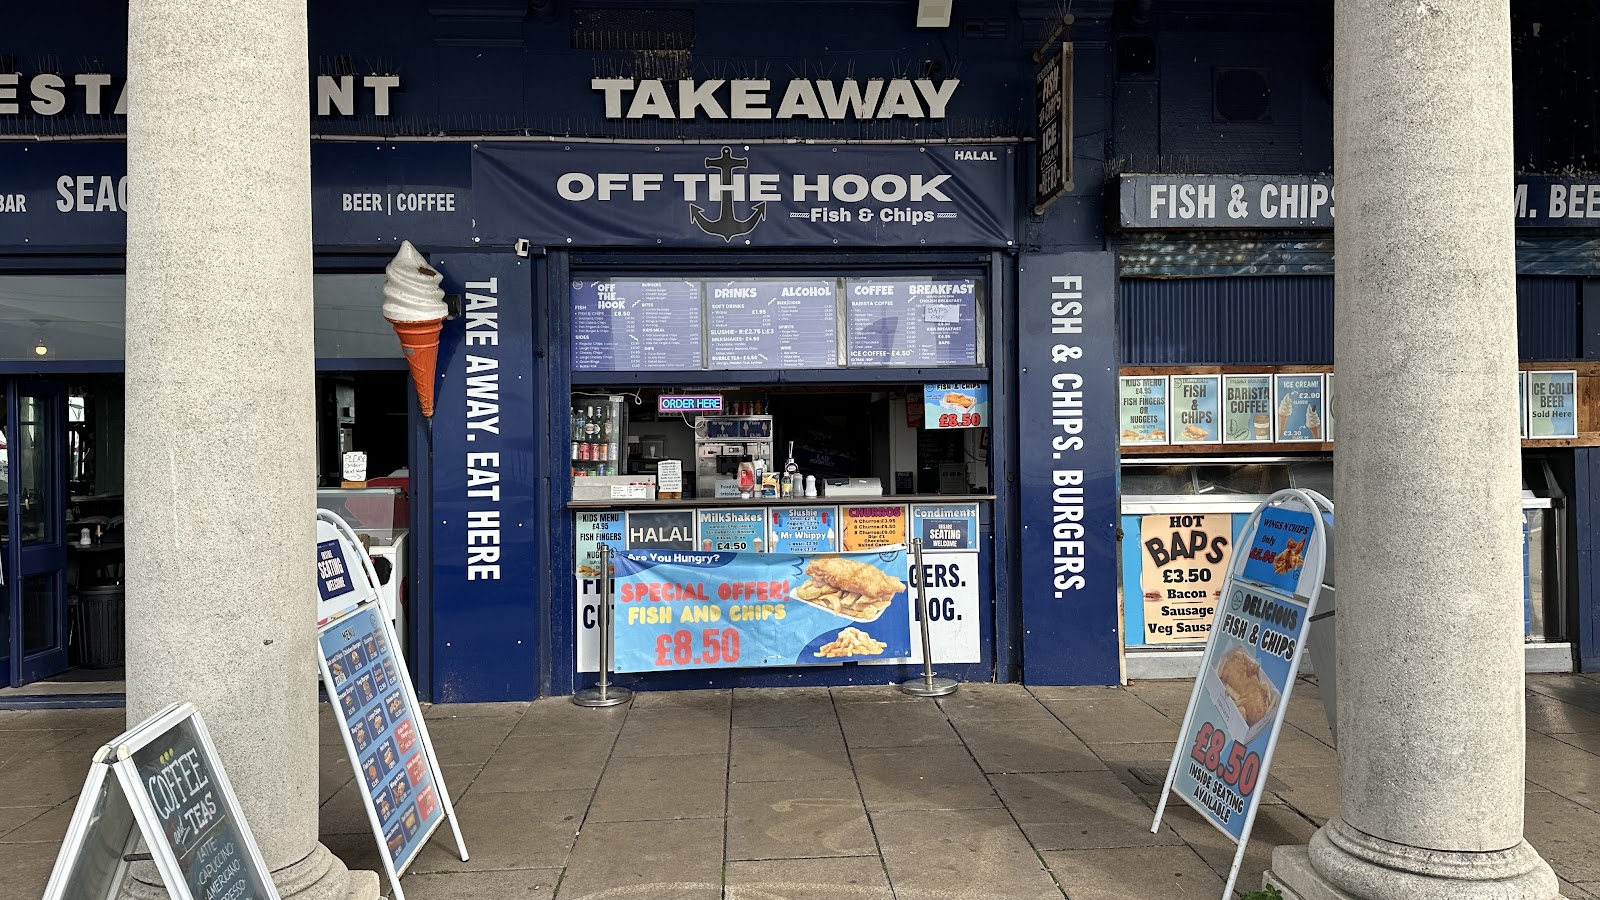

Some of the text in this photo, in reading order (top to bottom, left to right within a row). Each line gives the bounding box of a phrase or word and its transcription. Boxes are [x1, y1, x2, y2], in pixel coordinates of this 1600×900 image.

[591, 78, 960, 119] TAKEAWAY
[1042, 121, 1057, 154] ICE
[954, 150, 997, 161] HALAL
[556, 172, 953, 202] OFF THE HOOK
[343, 193, 455, 212] BEER COFFEE
[1149, 184, 1217, 219] FISH
[1227, 184, 1249, 219] &
[811, 207, 935, 224] Fish & Chips
[597, 283, 616, 292] OFF
[714, 288, 758, 298] DRINKS
[781, 287, 832, 296] ALCOHOL
[854, 286, 894, 296] COFFEE
[908, 284, 974, 294] BREAKFAST
[597, 292, 617, 301] THE
[597, 300, 626, 309] HOOK
[1184, 384, 1206, 398] FISH
[1228, 387, 1270, 400] BARISTA
[1532, 382, 1574, 396] ICE COLD
[662, 398, 720, 409] ORDER HERE
[1191, 399, 1198, 410] &
[1230, 400, 1268, 414] COFFEE
[1540, 395, 1564, 408] BEER
[1140, 406, 1148, 414] OR
[1182, 410, 1212, 424] CHIPS
[1532, 410, 1572, 418] Sold Here
[939, 412, 981, 428] £8.50
[1130, 416, 1158, 424] NUGGETS
[465, 277, 501, 581] TAKE AWAY. EAT HERE
[1051, 275, 1086, 599] FISH & CHIPS. BURGERS.
[582, 514, 619, 522] KIDS MENU
[701, 512, 762, 522] MilkShakes
[848, 507, 901, 517] CHURROS
[914, 508, 976, 518] Condiments
[1170, 516, 1204, 528] HOT
[1264, 519, 1283, 530] WINGS
[1288, 523, 1310, 534] CHIPS
[580, 532, 622, 541] FISH FINGERS
[630, 527, 692, 542] HALAL
[794, 532, 826, 540] Whippy
[930, 529, 961, 540] SEATING
[717, 542, 746, 550] £4.50
[1144, 530, 1228, 568] BAPS
[650, 553, 672, 562] You
[674, 554, 720, 564] Hungry?
[1162, 568, 1212, 583] £3.50
[620, 582, 710, 602] SPECIAL
[717, 580, 790, 602] OFFER!
[1167, 589, 1206, 598] Bacon
[628, 604, 786, 625] FISH AND CHIPS
[1161, 606, 1214, 618] Sausage
[1242, 594, 1298, 631] DELICIOUS
[1148, 622, 1212, 635] Veg Sausa
[1222, 612, 1296, 660] FISH & CHIPS
[654, 627, 740, 666] £8.50
[1190, 722, 1260, 798] £8.50
[149, 748, 209, 820] COFFEE
[1188, 762, 1244, 814] INSIDE SEATING
[1193, 785, 1231, 824] AVAILABLE
[173, 792, 217, 844] and TEAS
[196, 836, 218, 862] LATTE
[199, 842, 234, 884] CAPUCCINO
